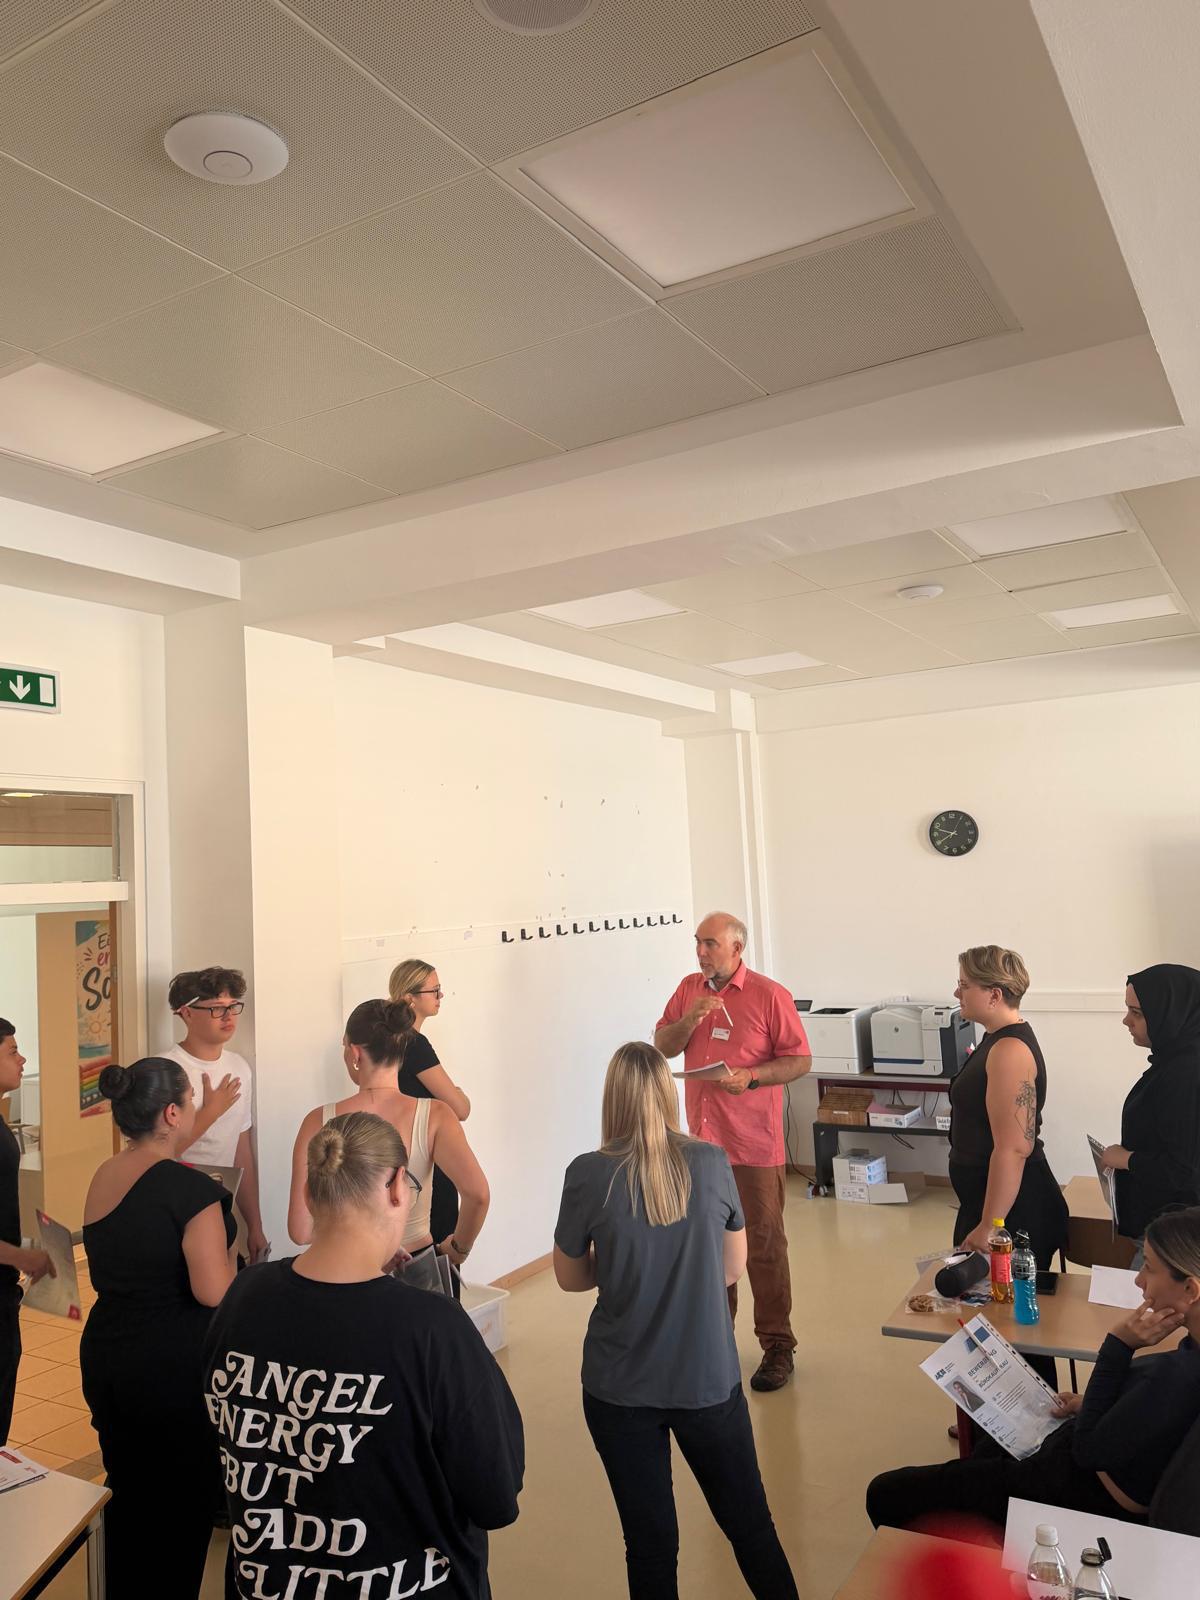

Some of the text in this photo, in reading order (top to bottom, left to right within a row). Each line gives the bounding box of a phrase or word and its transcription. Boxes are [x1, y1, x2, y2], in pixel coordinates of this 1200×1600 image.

[211, 1350, 393, 1421] ANGEL
[204, 1392, 374, 1473] ENERGY
[219, 1446, 315, 1507] BUT
[232, 1508, 368, 1557] ADD
[236, 1547, 451, 1600] LITTLE
